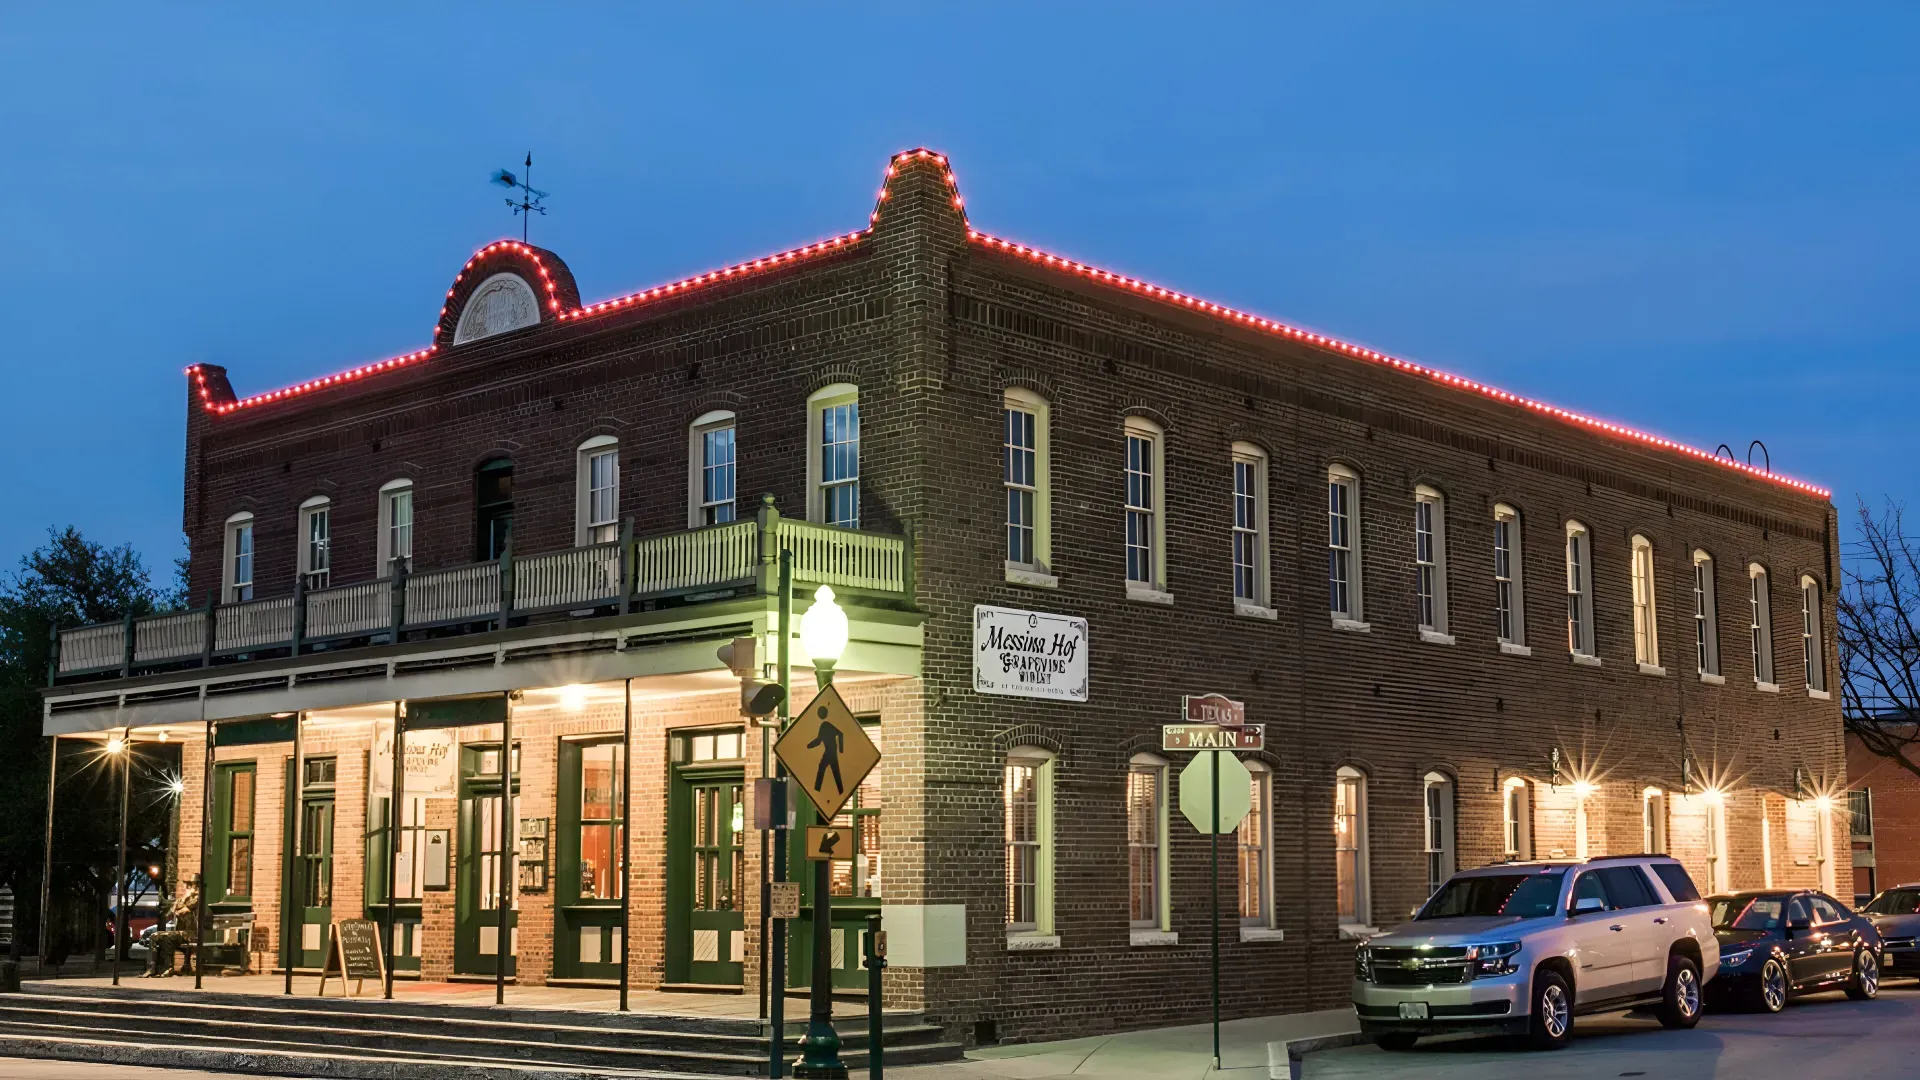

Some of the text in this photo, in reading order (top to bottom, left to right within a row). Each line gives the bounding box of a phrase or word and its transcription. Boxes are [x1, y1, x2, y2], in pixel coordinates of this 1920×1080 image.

[981, 625, 1080, 664] Messina Hof
[1188, 731, 1238, 748] MAIN
